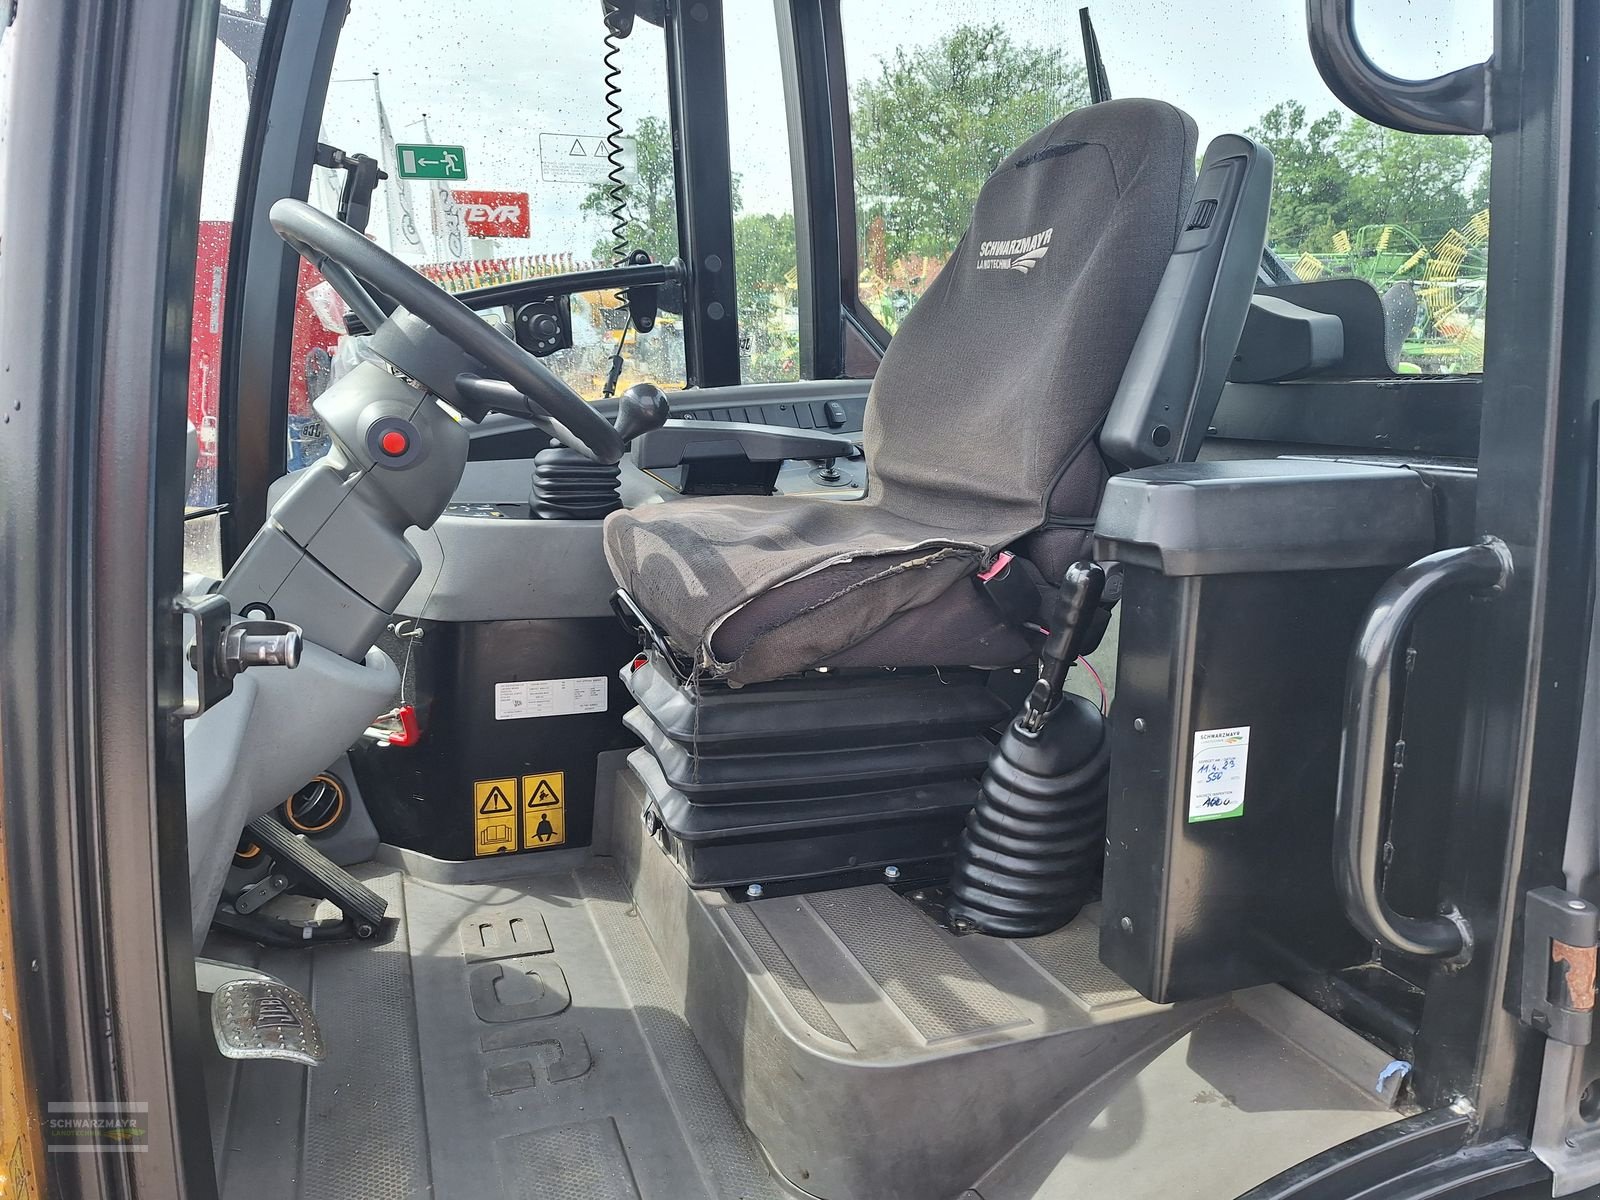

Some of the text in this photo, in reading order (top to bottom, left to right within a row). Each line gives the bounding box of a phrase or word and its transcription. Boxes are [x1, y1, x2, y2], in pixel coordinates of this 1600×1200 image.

[980, 228, 1053, 257] SCHWARZMAYR
[1200, 731, 1240, 740] SCHWARZMAYR
[258, 999, 294, 1022] JCB
[458, 907, 593, 1097] JCB
